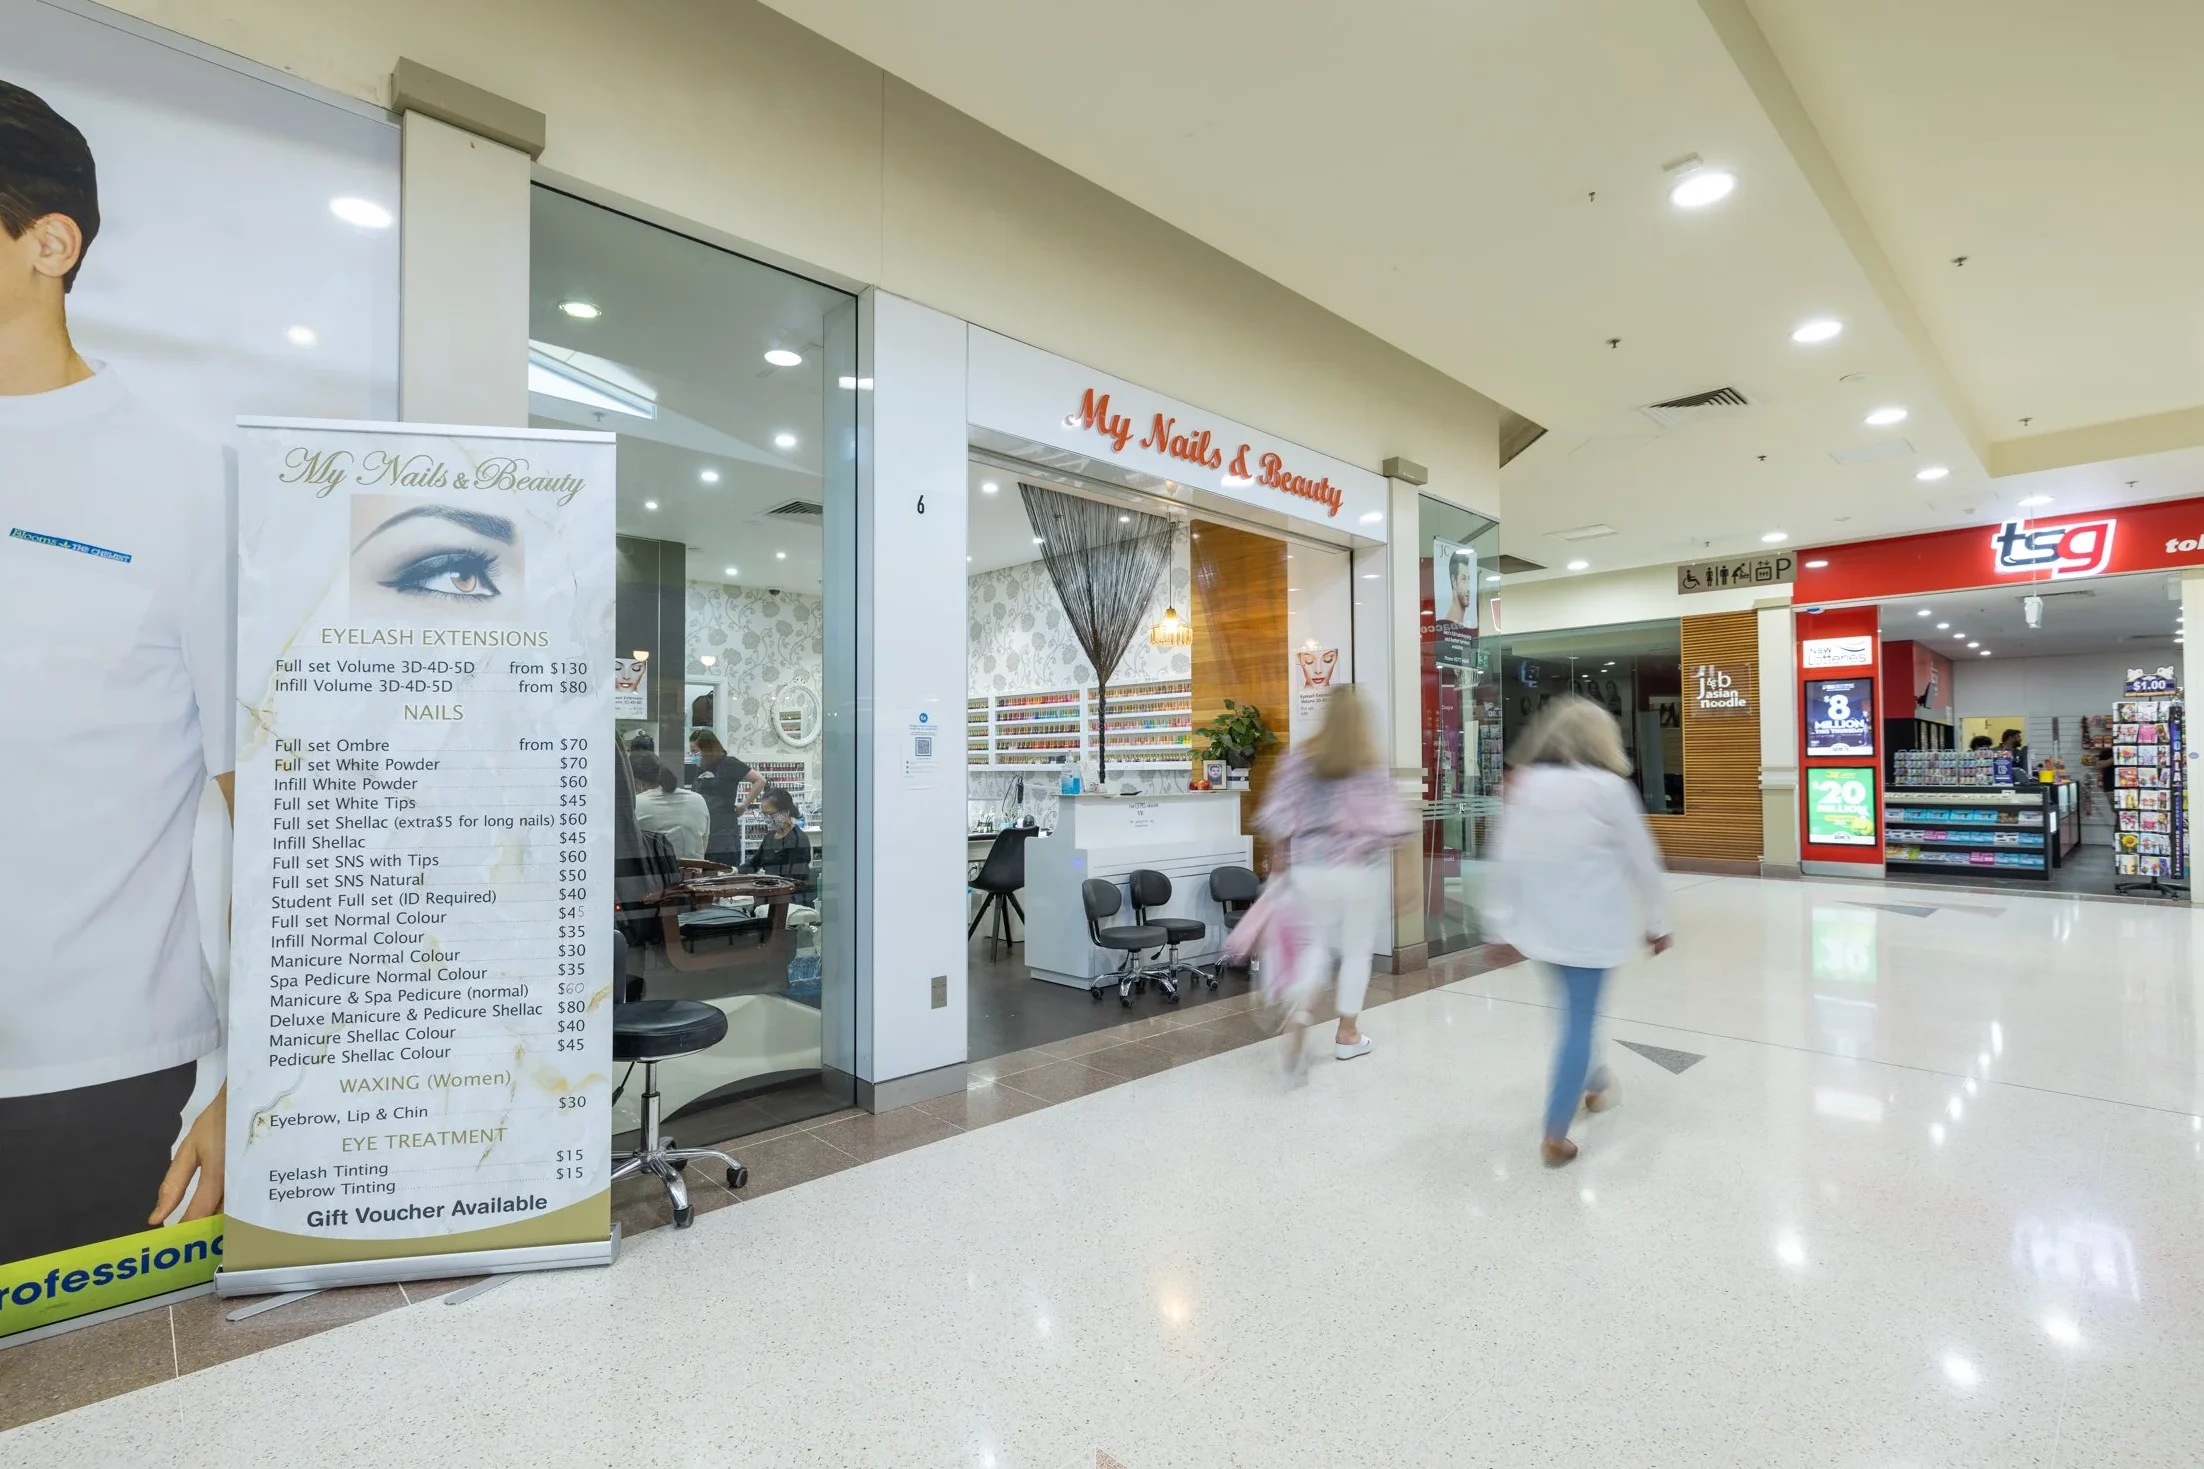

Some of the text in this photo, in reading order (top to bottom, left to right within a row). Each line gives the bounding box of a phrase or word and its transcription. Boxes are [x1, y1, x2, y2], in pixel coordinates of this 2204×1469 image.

[1066, 387, 1343, 517] My Nails & Beauty
[278, 446, 585, 507] My Nails & Beauty
[917, 495, 925, 514] 6
[1994, 520, 2115, 578] tsg
[321, 628, 549, 648] EYELASH EXTENSIONS
[276, 660, 587, 676] Full set Volume 3D-4D-5D from $130
[1808, 653, 1866, 666] Lotteries
[275, 679, 587, 695] Infill Volume 3D-4D-5D from $80
[1706, 688, 1739, 699] asian
[2133, 680, 2166, 691] $1.00
[404, 704, 464, 721] NAILS
[1700, 697, 1747, 708] noodle
[1814, 718, 1864, 729] MILLION
[275, 738, 588, 752] Full set Ombre from $70
[274, 757, 588, 771] Full set White Powder $70
[274, 776, 588, 791] Infill White Powder $60
[274, 794, 586, 812] Full set White Tips $45
[273, 813, 587, 830] Full set Shellac (extra$5 for long nails) $60
[273, 832, 586, 850] Infill Shellac $45
[273, 850, 587, 869] Full set SNS with Tips $60
[272, 869, 587, 889] Full set SNS Natural $50
[272, 888, 586, 909] Student Full set (ID Required) $40
[271, 906, 585, 928] Full set Normal Colour $45
[271, 926, 585, 948] Infill Normal Colour $35
[271, 944, 586, 968] Manicure Normal Colour $30
[270, 963, 585, 991] Spa Pedicure Normal Colour $35
[270, 982, 585, 1008] Manicure & Spa Pedicure (normal) $60
[270, 1001, 585, 1028] Deluxe Manicure & Pedicure Shellac $80
[269, 1020, 585, 1047] Manicure Shellac Colour $40
[269, 1039, 584, 1067] Pedicure Shellac Colour $45
[339, 1071, 511, 1093] WAXING (Women)
[270, 1096, 587, 1128] Eyebrow, Lip & Chin $30
[342, 1128, 508, 1152] EYE TREATMENT
[269, 1150, 583, 1183] Eyelash Tinting $15
[269, 1167, 583, 1201] Eyebrow Tinting $15
[307, 1195, 548, 1228] Gift Voucher Available
